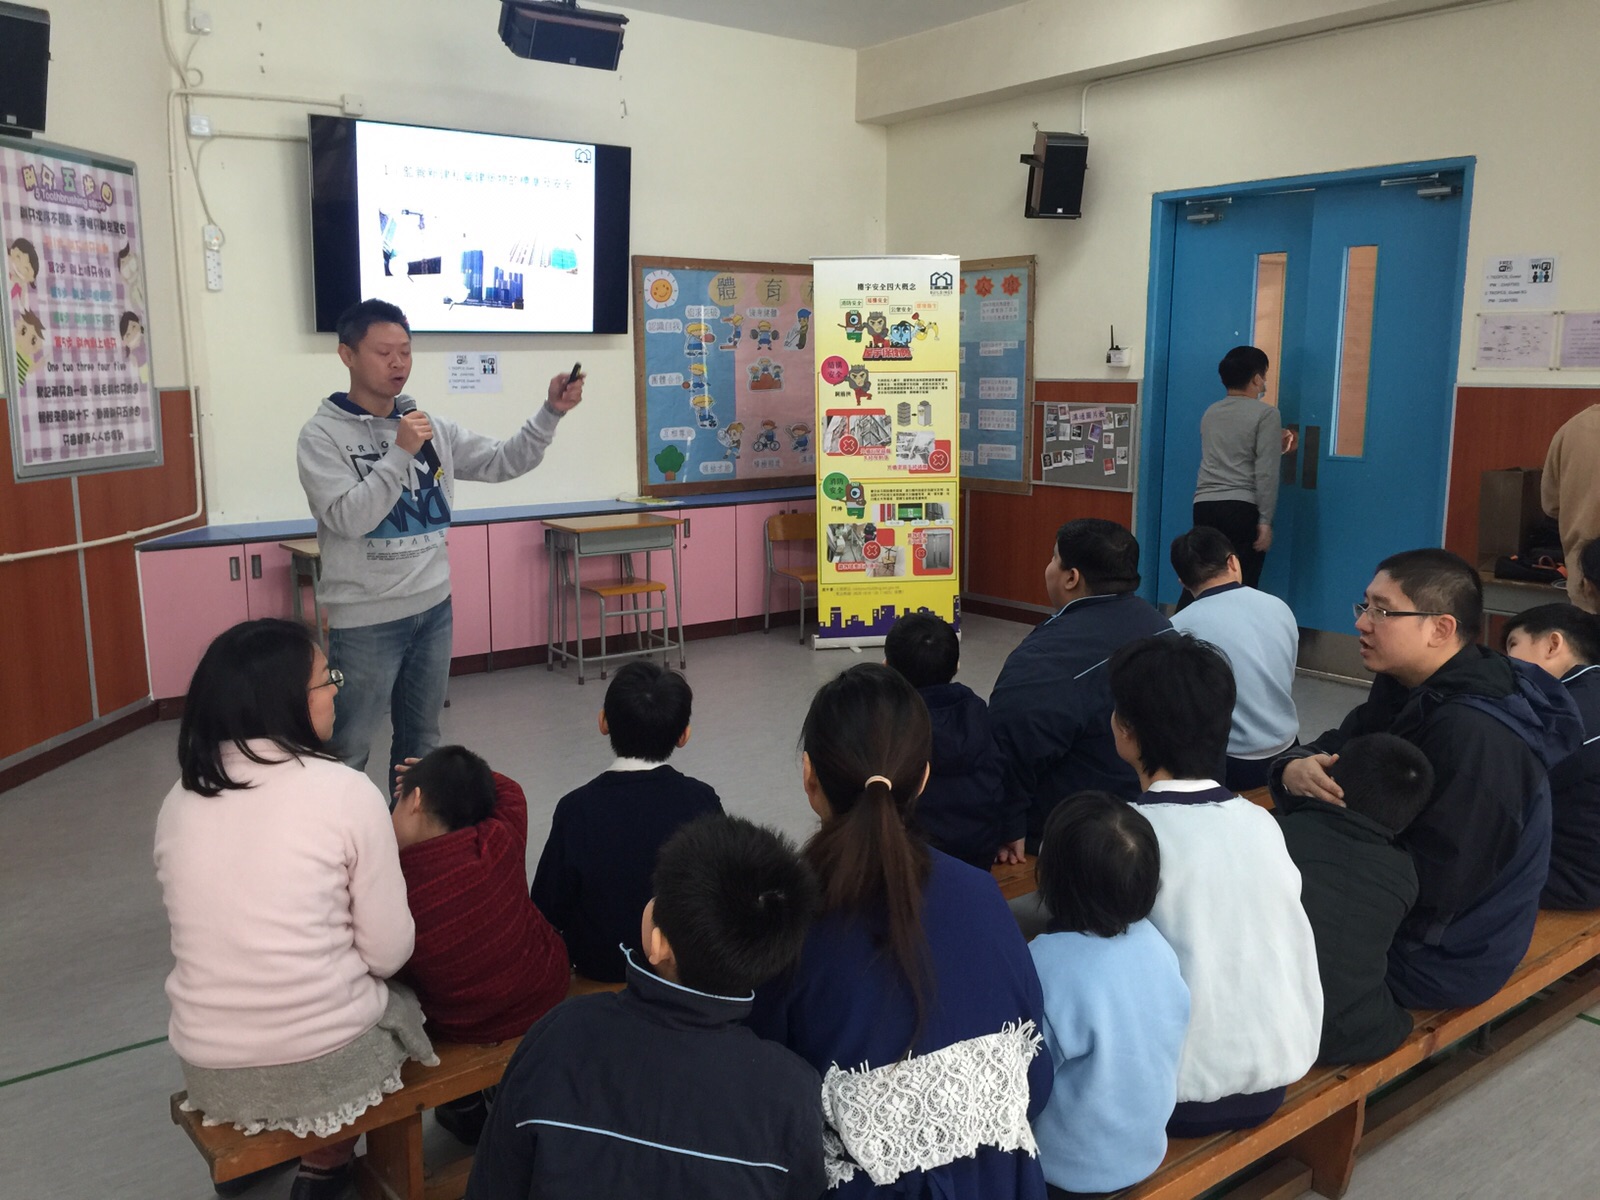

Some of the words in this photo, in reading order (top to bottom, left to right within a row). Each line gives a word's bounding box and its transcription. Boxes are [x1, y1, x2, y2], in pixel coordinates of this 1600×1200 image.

[648, 320, 682, 333] 認識自我
[47, 361, 59, 373] One
[62, 361, 73, 373] two
[76, 361, 95, 372] three
